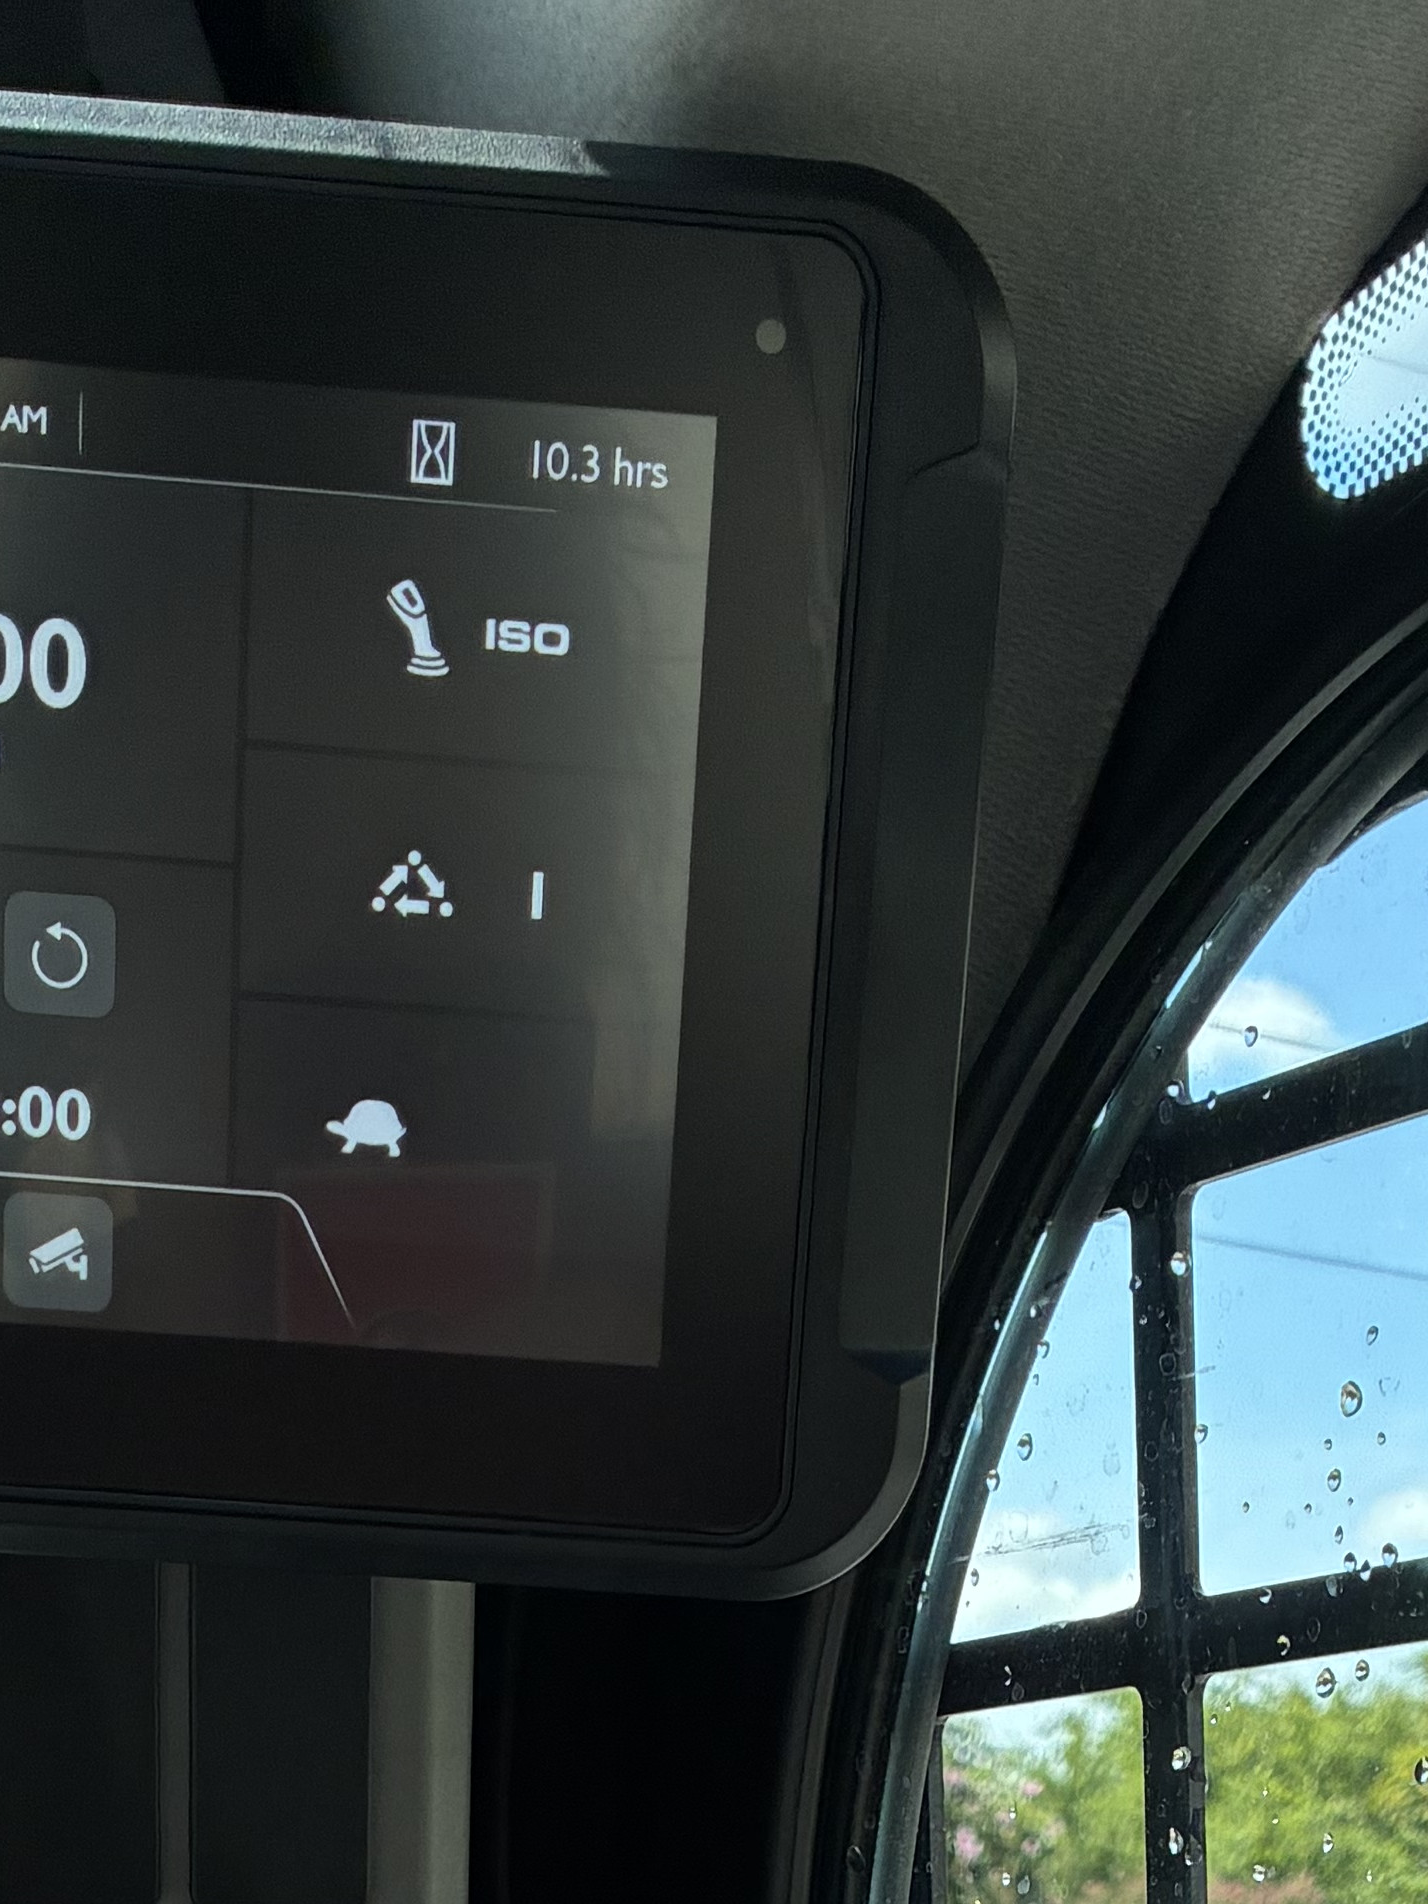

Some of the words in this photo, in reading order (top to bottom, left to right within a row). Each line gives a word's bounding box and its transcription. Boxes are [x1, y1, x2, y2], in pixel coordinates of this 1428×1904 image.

[0, 404, 49, 435] AM
[531, 439, 601, 484] 10.3
[613, 446, 670, 490] hrs
[484, 618, 571, 657] ISO
